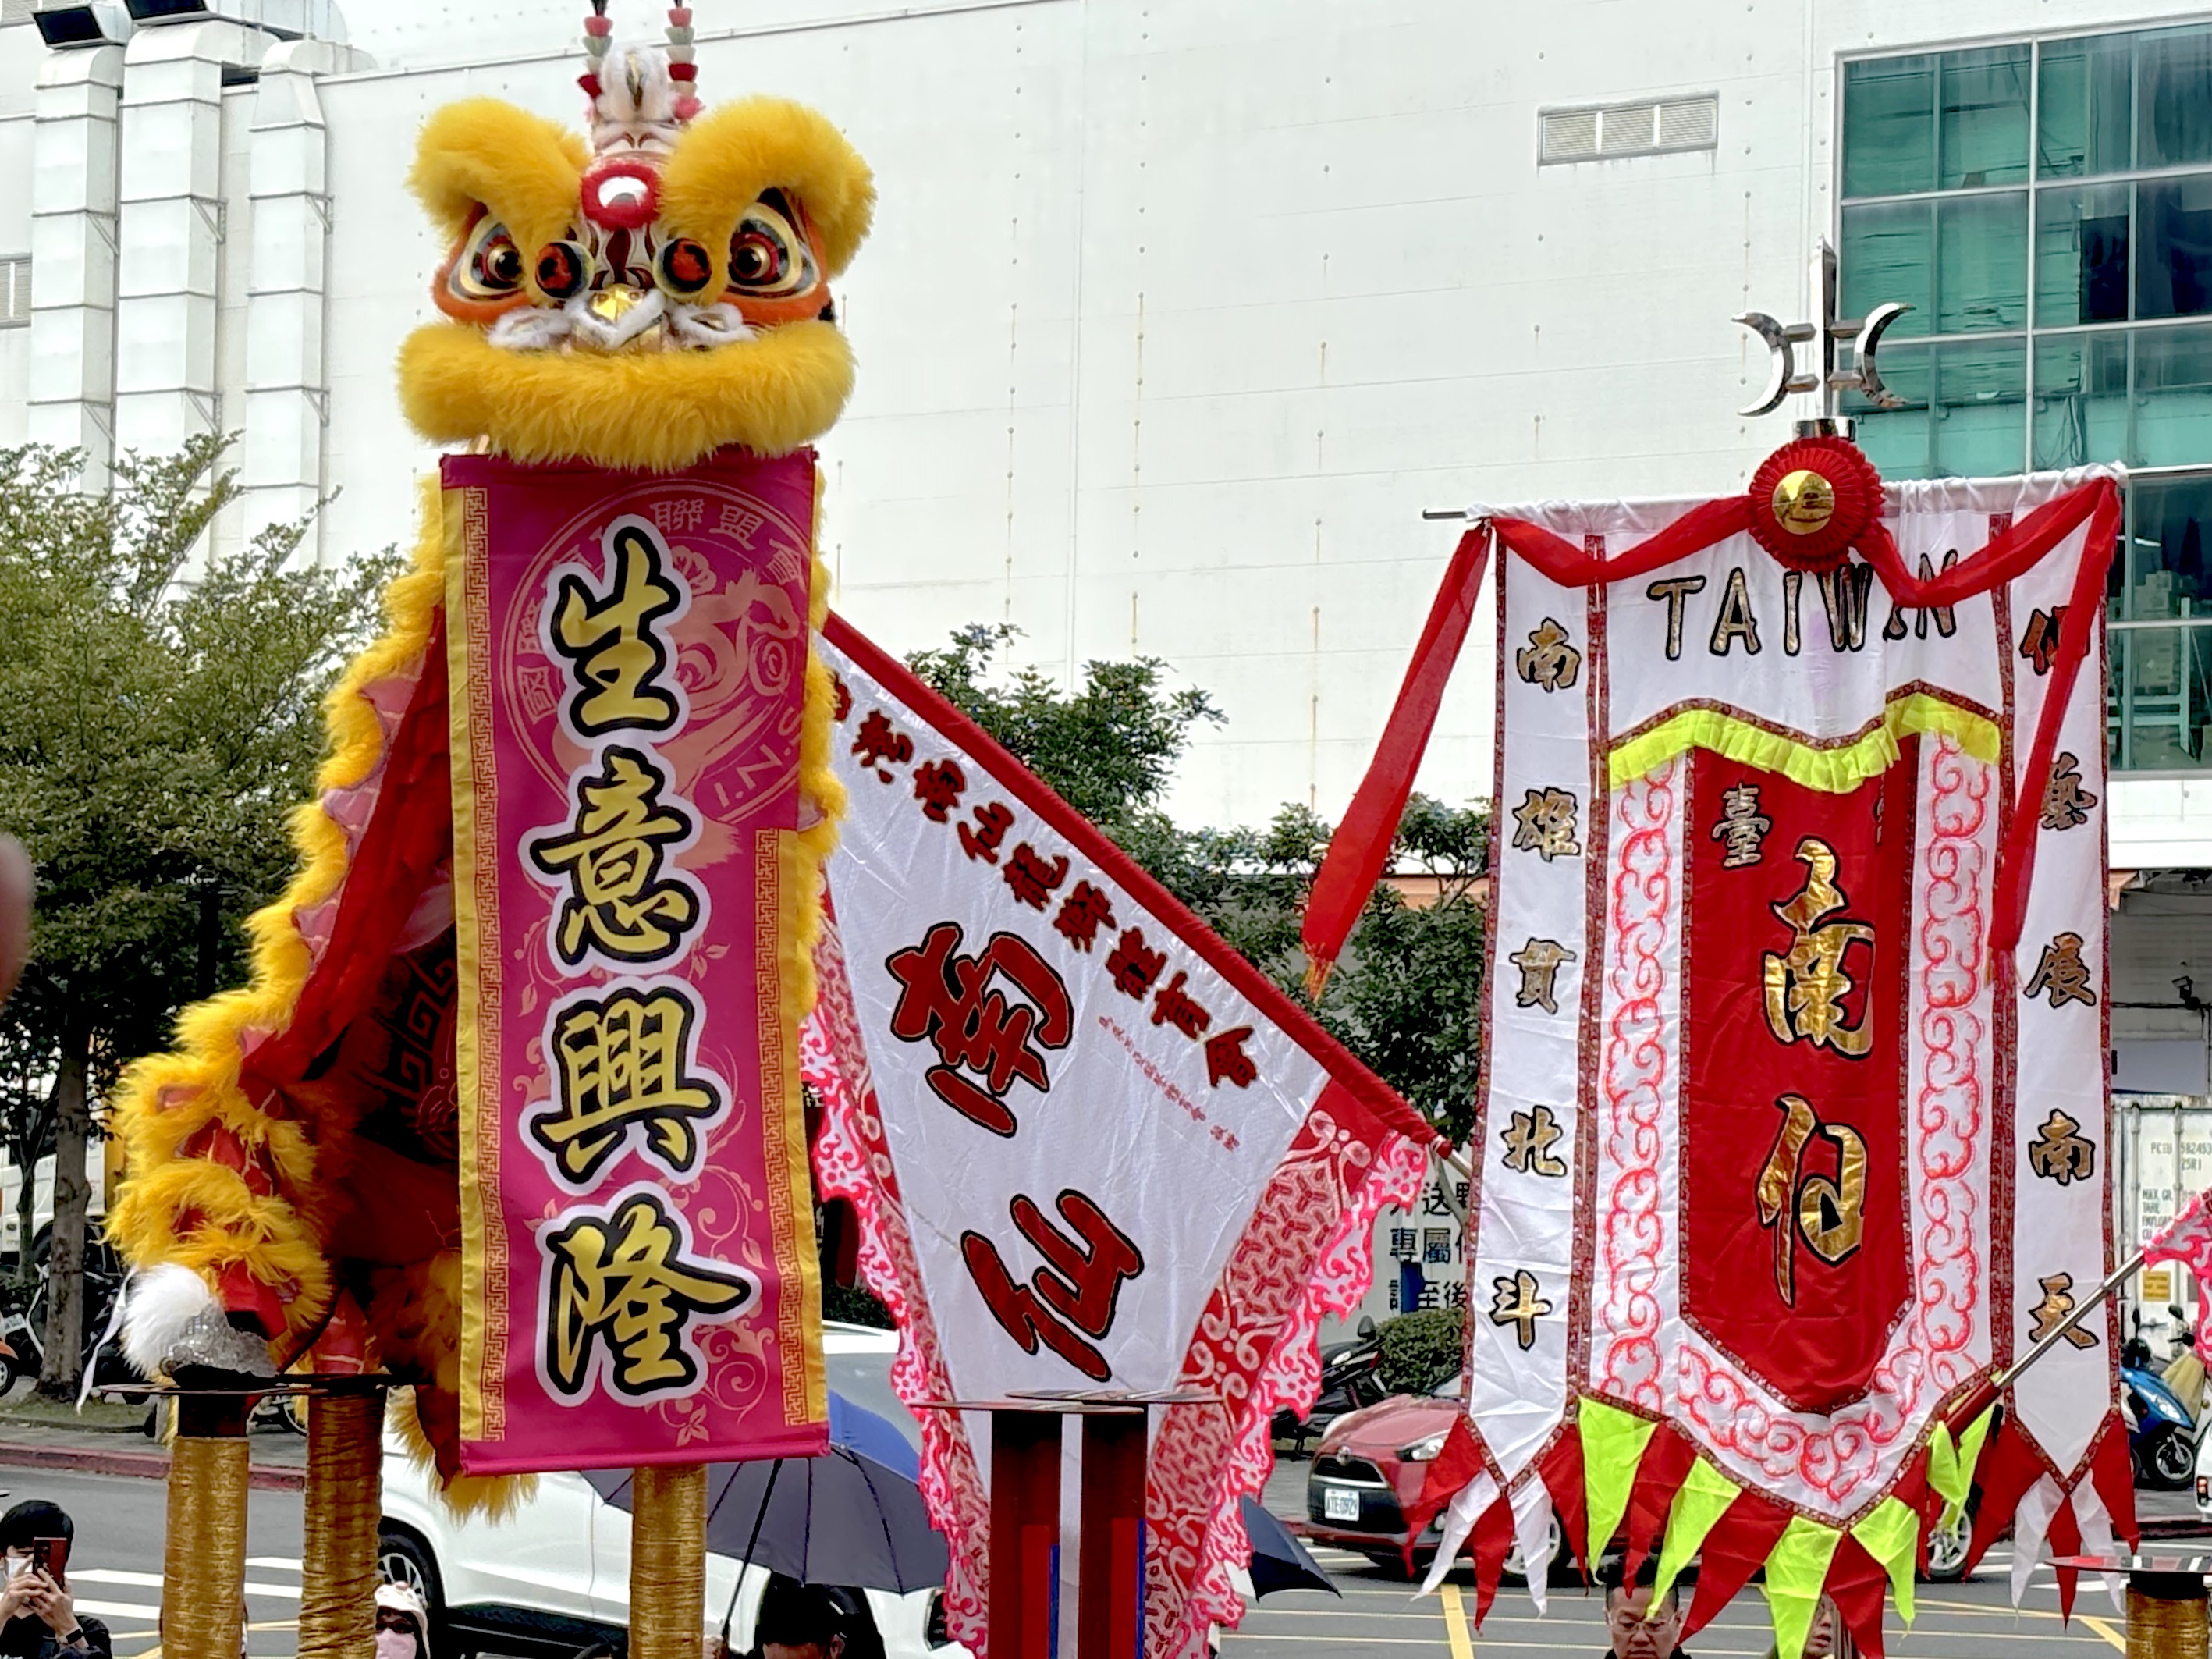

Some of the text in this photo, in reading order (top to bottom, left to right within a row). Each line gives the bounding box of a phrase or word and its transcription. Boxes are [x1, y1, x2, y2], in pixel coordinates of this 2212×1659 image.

[524, 520, 757, 1401] 生意興隆
[885, 922, 1144, 1381] 南仙
